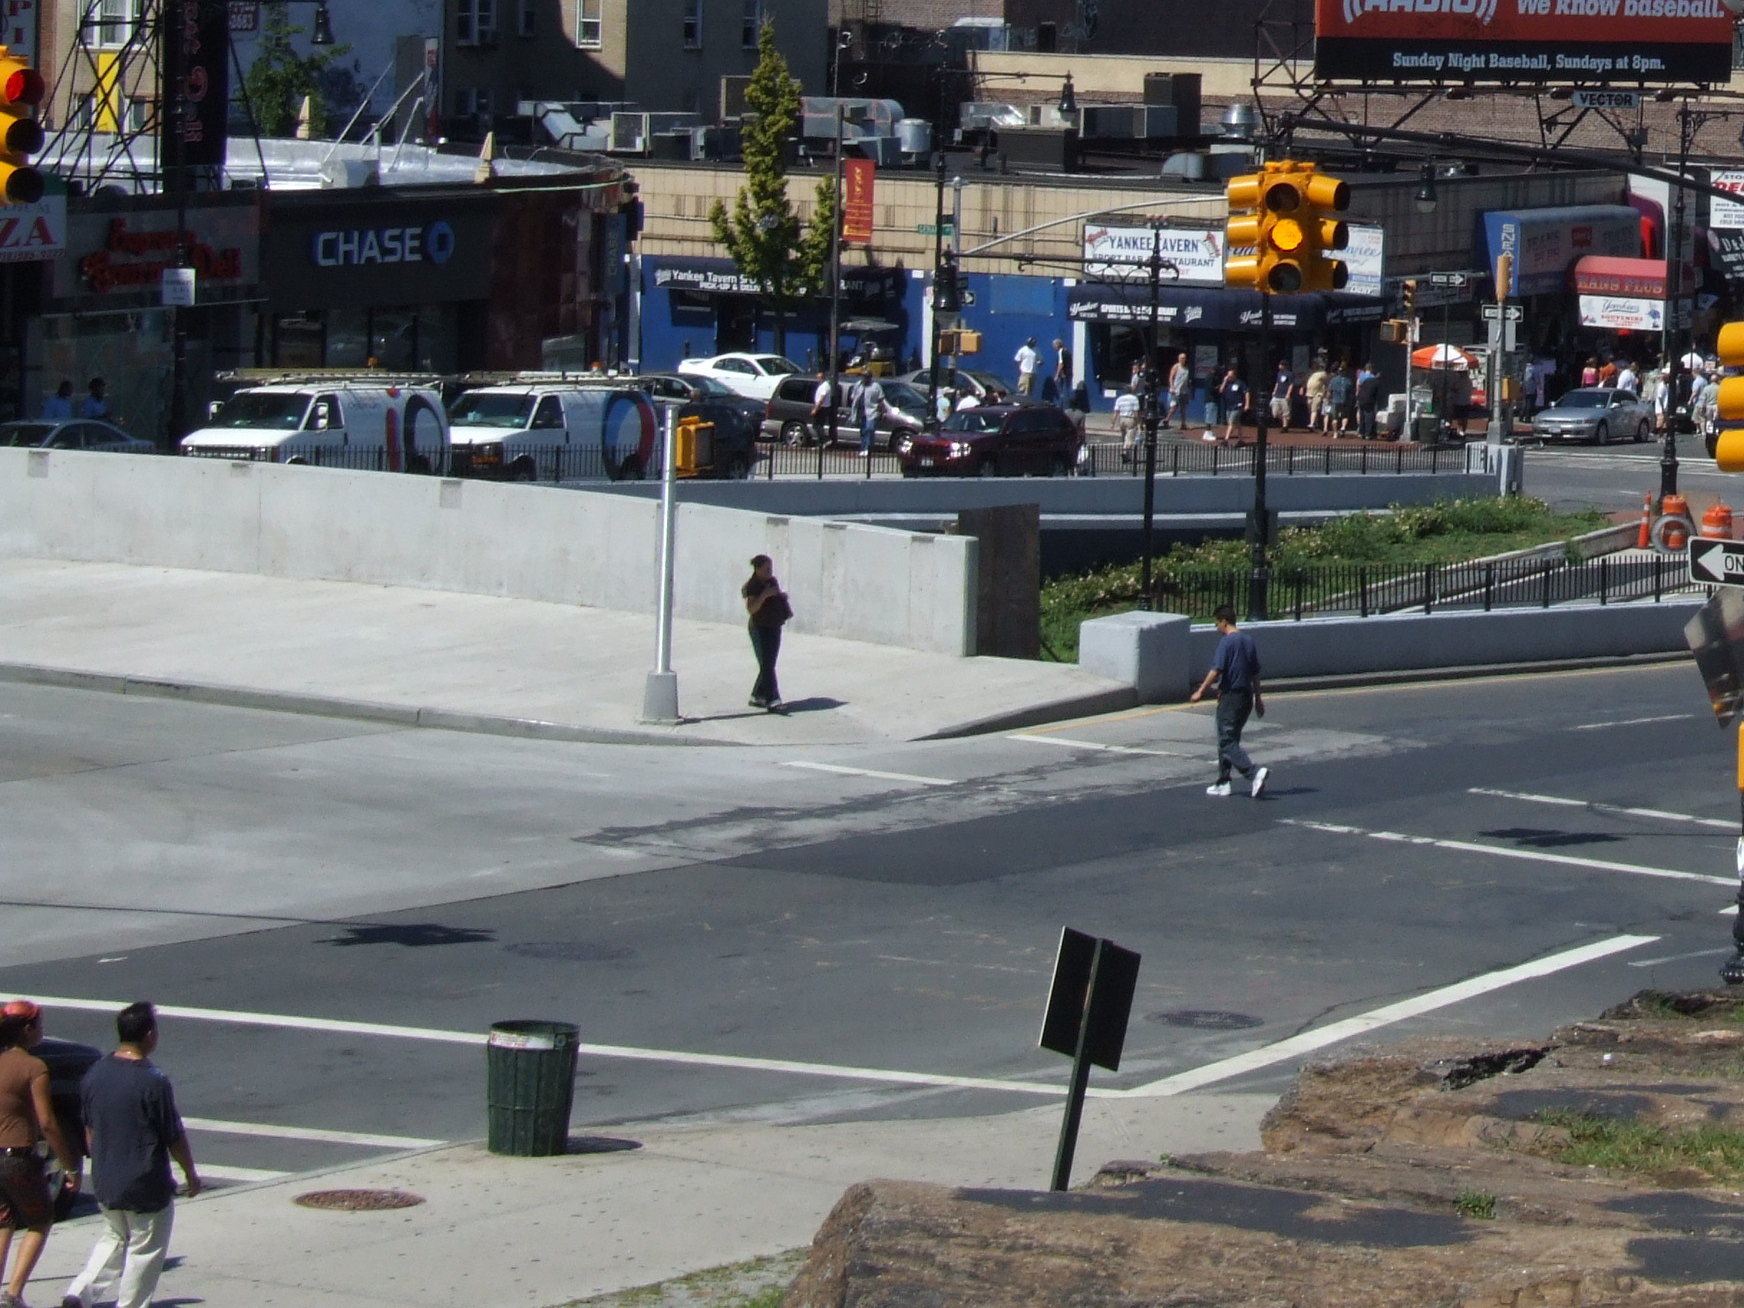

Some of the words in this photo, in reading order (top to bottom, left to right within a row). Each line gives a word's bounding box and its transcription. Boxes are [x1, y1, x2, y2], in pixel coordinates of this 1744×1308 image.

[1392, 52, 1445, 71] Sunday
[1448, 52, 1485, 72] Night
[1489, 52, 1552, 72] Baseball,
[1555, 53, 1613, 73] Sundays
[1615, 55, 1629, 70] at
[1632, 55, 1666, 74] 8pm.
[1579, 94, 1634, 107] VECTOR
[0, 216, 57, 248] ZA
[316, 226, 423, 267] CHASE
[1109, 235, 1153, 251] YANKEE
[1158, 237, 1199, 252] AVERN
